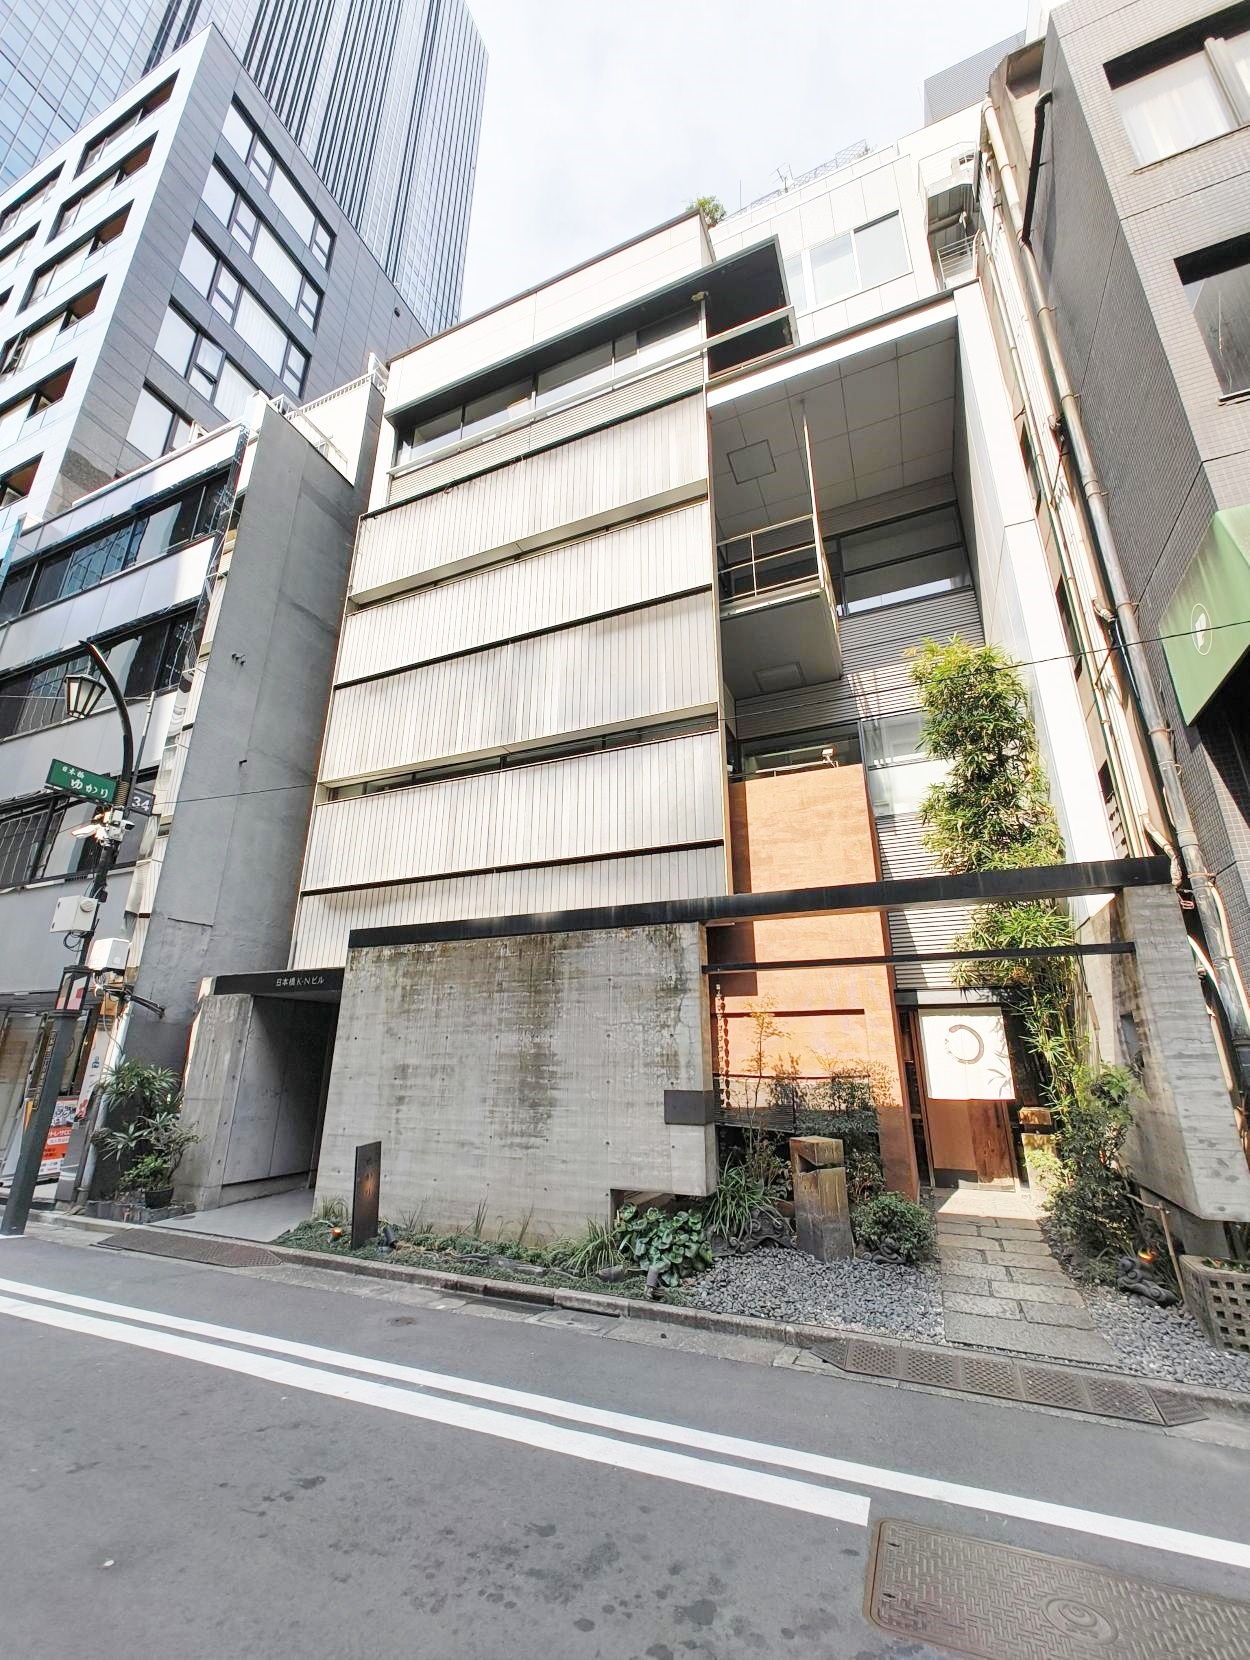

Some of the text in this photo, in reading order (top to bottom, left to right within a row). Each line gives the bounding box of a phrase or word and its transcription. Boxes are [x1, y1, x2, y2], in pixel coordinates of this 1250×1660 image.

[70, 779, 109, 798] ゆかり
[131, 796, 150, 811] 34
